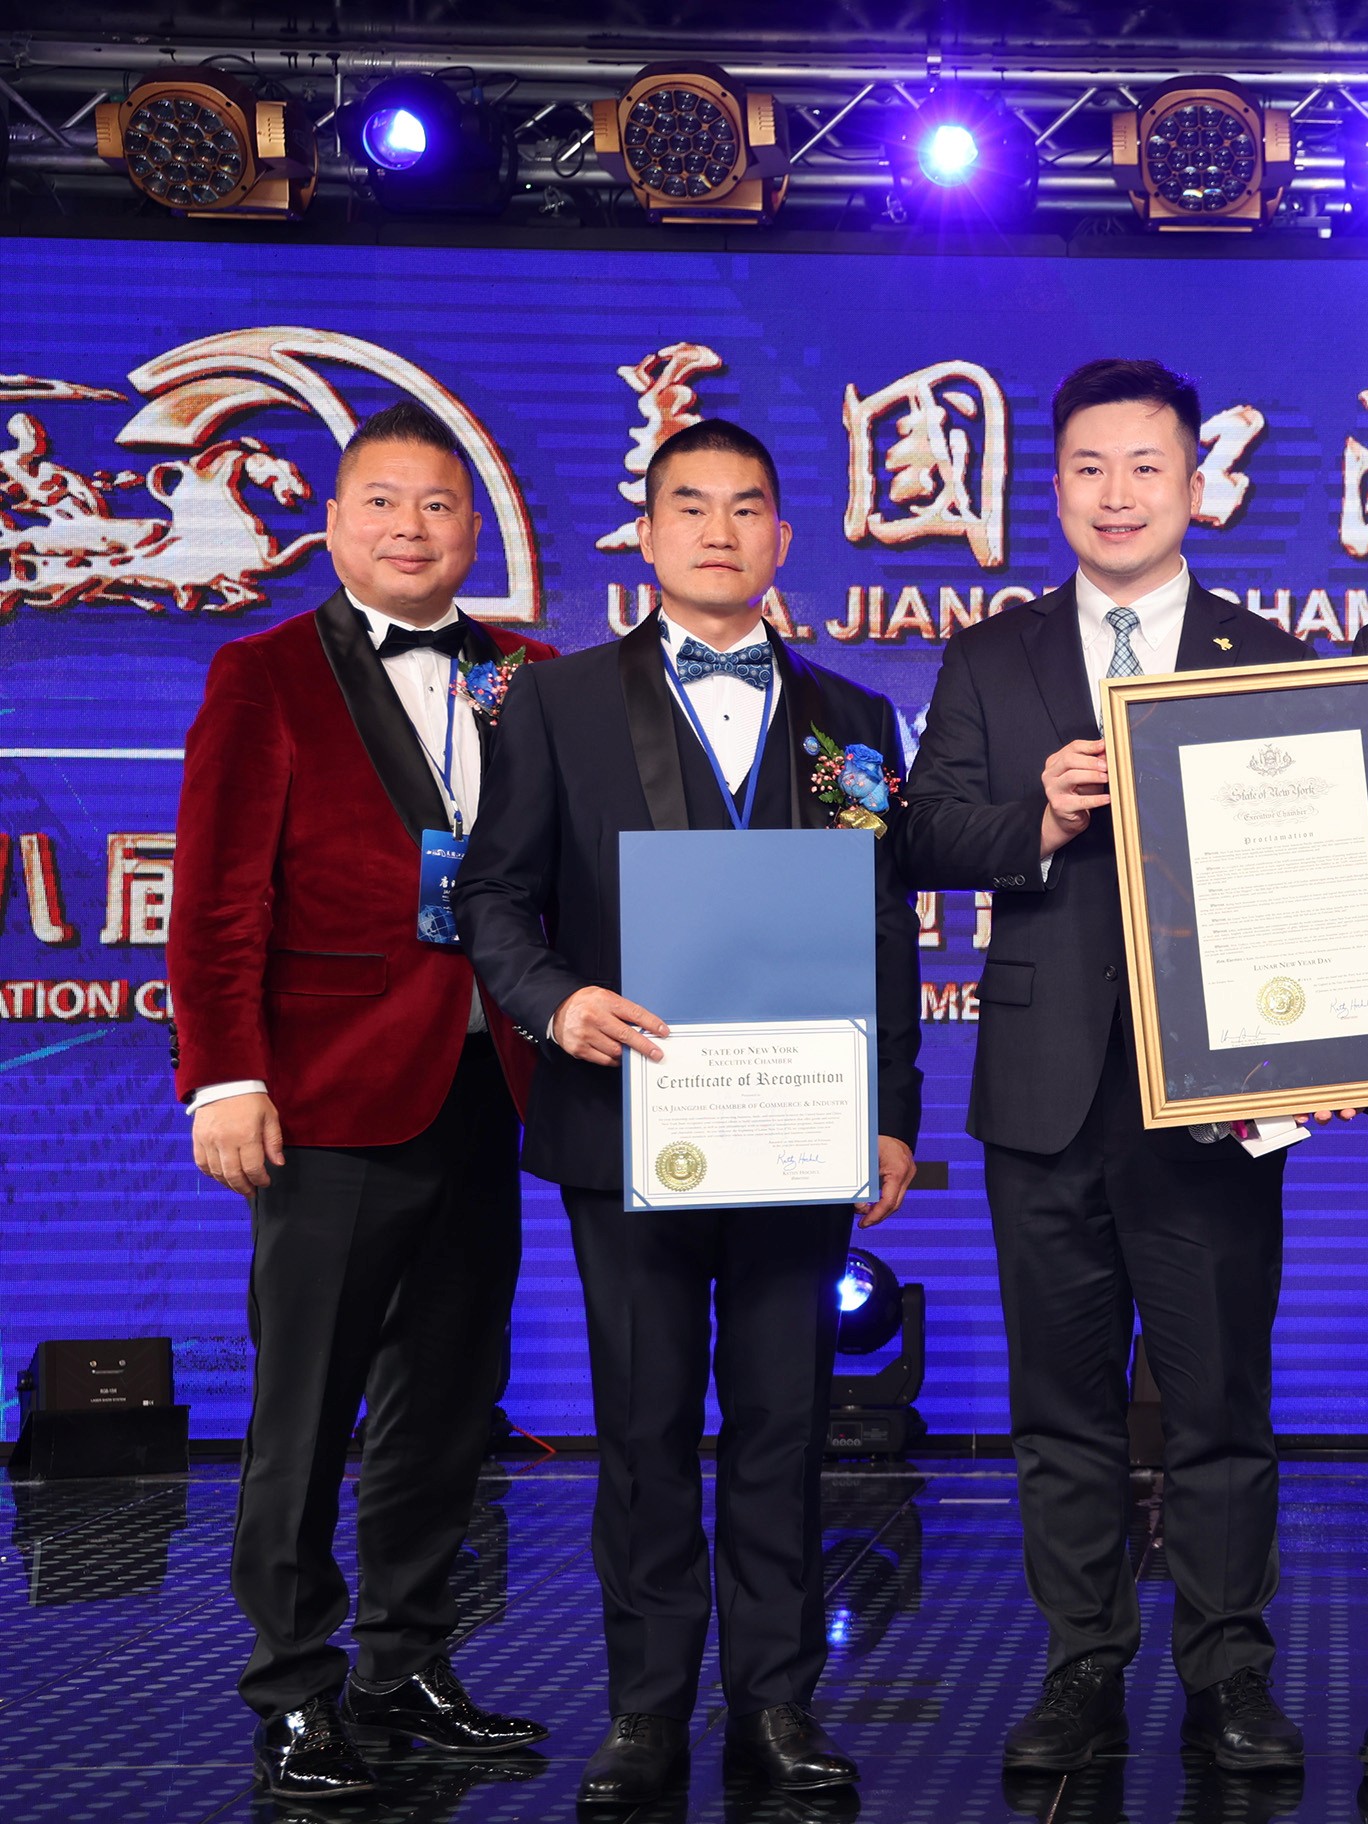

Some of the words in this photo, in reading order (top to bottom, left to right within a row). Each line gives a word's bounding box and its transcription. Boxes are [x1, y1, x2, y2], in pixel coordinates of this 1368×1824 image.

[1253, 963, 1278, 972] LUNAR
[1279, 961, 1296, 970] NEW
[1297, 960, 1316, 968] YEAR
[1317, 957, 1333, 966] DAY
[701, 1047, 731, 1057] STATE
[748, 1046, 769, 1055] NEW
[771, 1046, 799, 1054] YORK
[708, 1058, 751, 1067] EXECUTIVE
[754, 1057, 793, 1066] CHAMBER
[656, 1074, 733, 1090] Certificate
[738, 1073, 750, 1087] of
[756, 1071, 844, 1087] Recognition
[652, 1105, 669, 1113] USA
[709, 1102, 746, 1111] CHAMBER
[759, 1100, 802, 1109] COMMERCE
[812, 1099, 849, 1107] INDUSTRY
